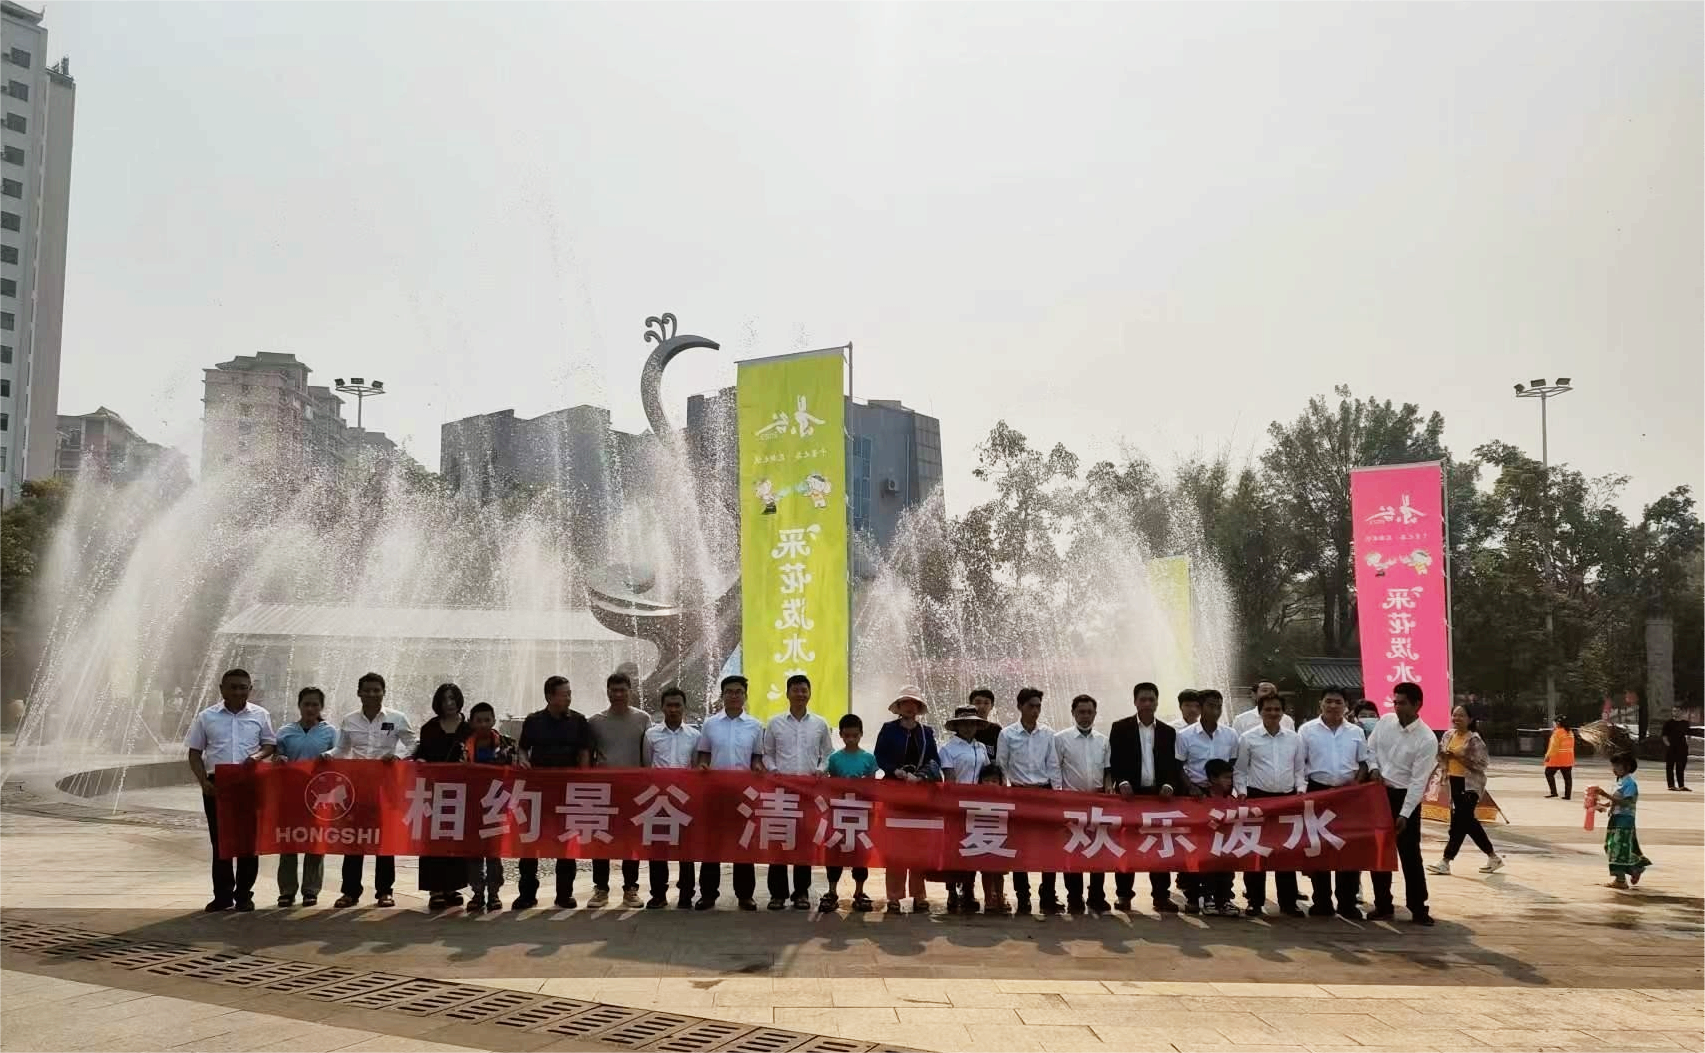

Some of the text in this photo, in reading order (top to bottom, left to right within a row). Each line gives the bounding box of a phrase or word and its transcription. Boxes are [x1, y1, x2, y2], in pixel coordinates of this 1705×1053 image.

[275, 827, 381, 846] HONGSHI
[402, 778, 1346, 860] 相约景谷 清凉一夏 欢乐泼水
